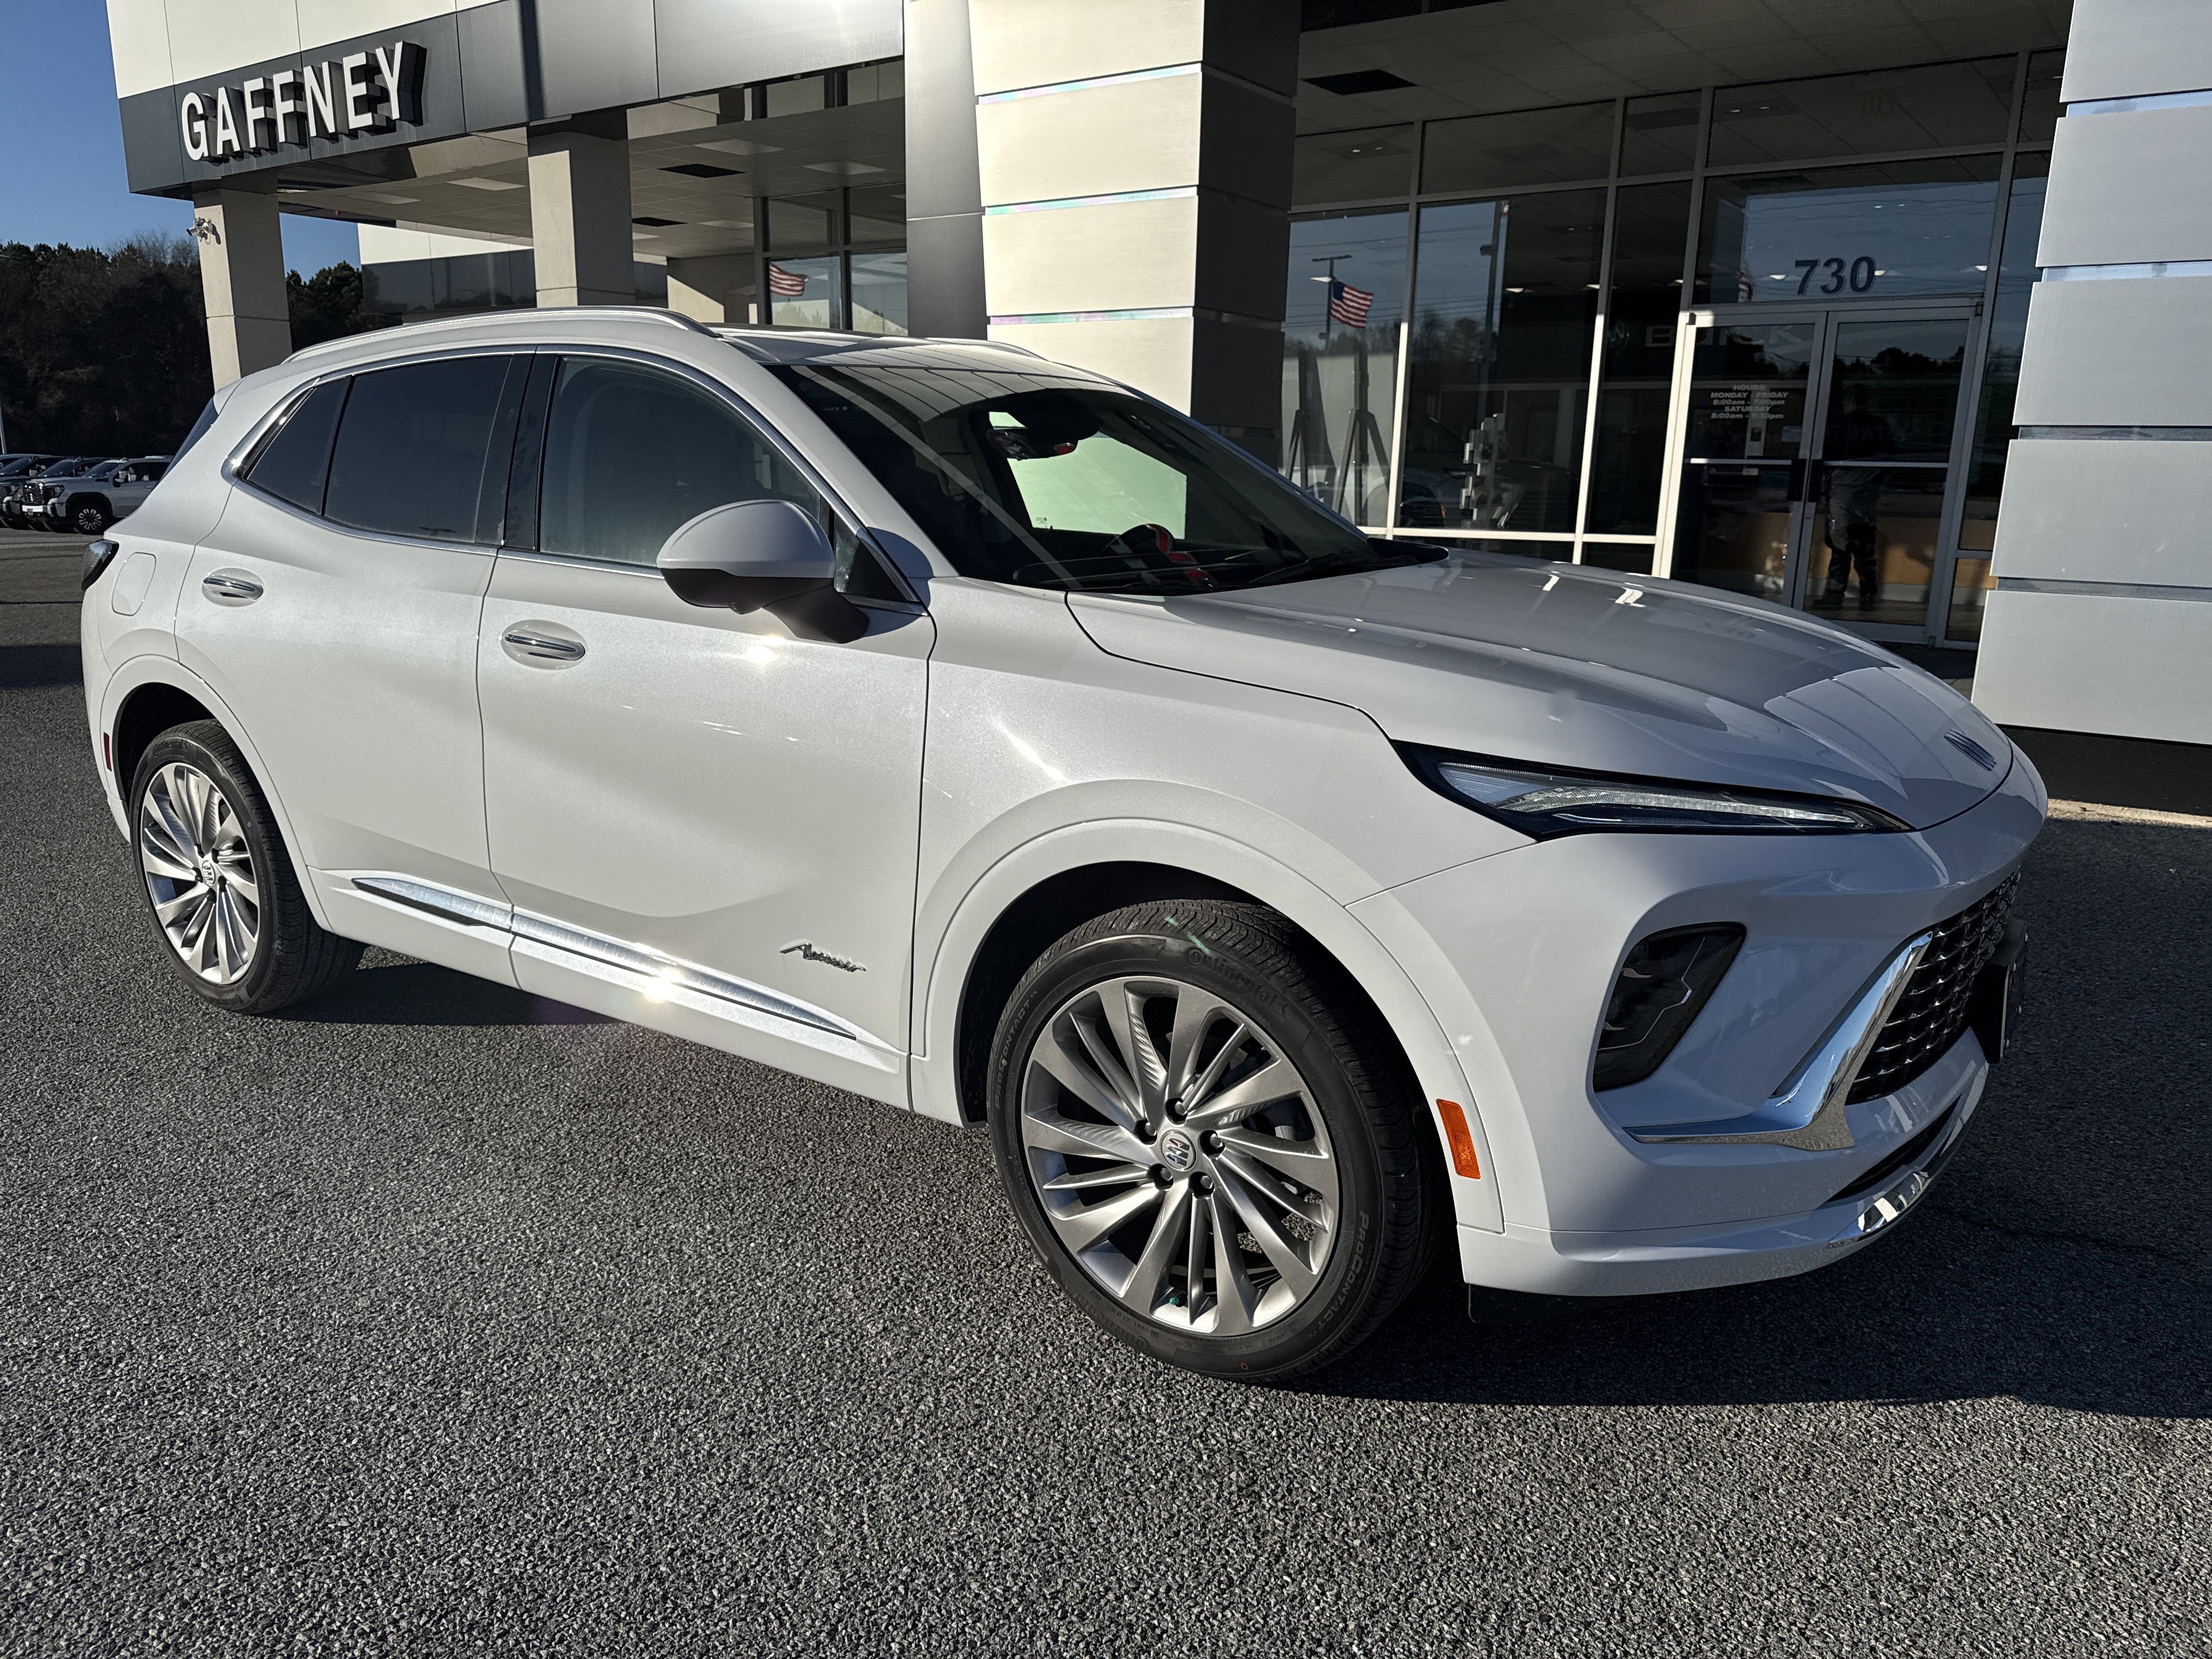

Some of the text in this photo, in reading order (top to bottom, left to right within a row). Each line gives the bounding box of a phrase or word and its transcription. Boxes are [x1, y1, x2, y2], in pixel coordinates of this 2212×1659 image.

[180, 41, 404, 161] GAFFNEY
[1795, 256, 1876, 295] 730
[1184, 946, 1279, 1008] Continental
